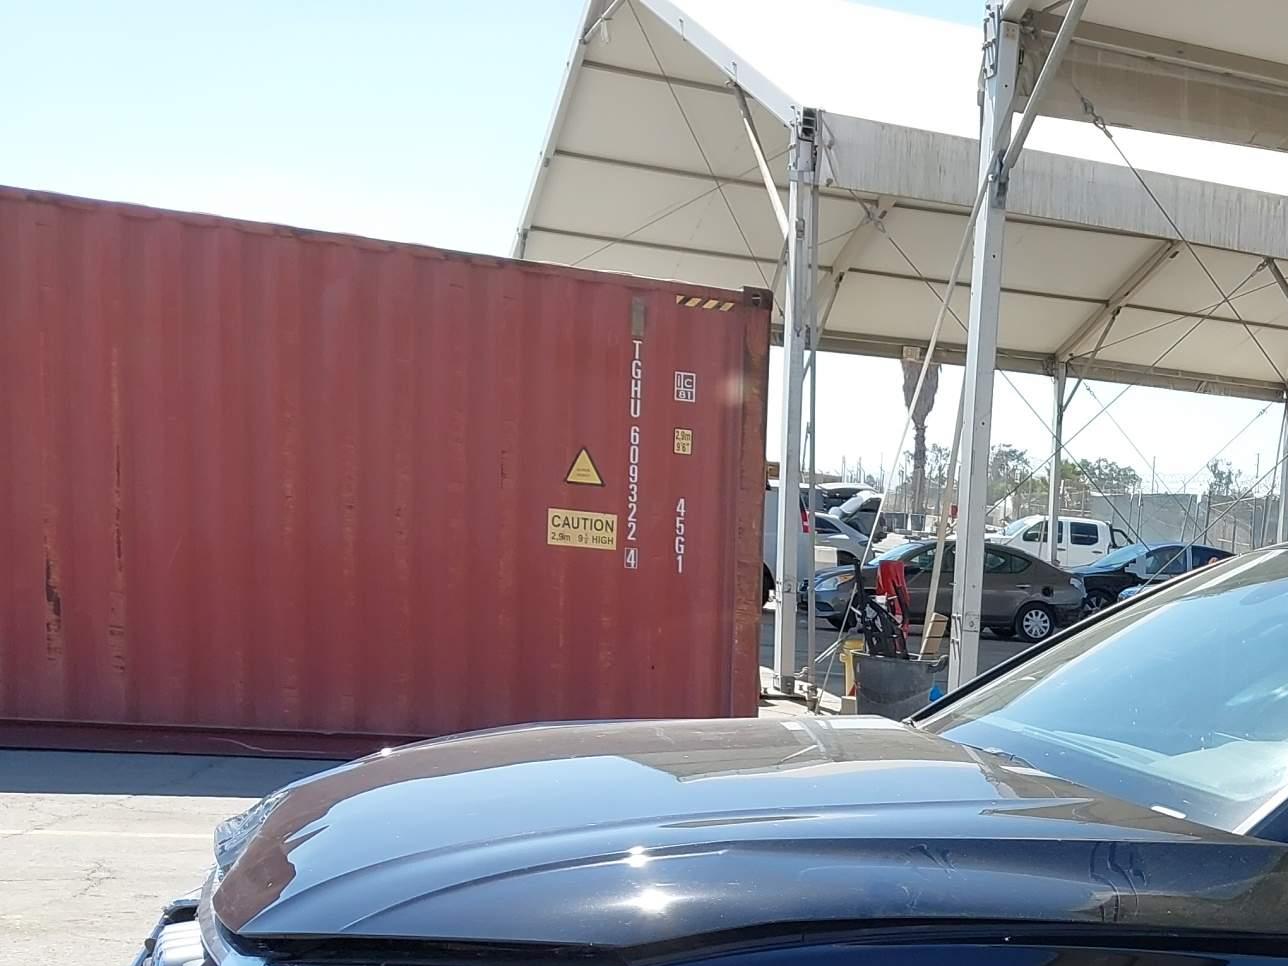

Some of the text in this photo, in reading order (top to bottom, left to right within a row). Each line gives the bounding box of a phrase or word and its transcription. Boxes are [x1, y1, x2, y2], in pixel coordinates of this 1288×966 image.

[626, 340, 643, 569] TGHU 609322 4
[551, 514, 614, 533] CAUTION
[591, 535, 614, 545] HIGH
[675, 498, 686, 574] 45G1
